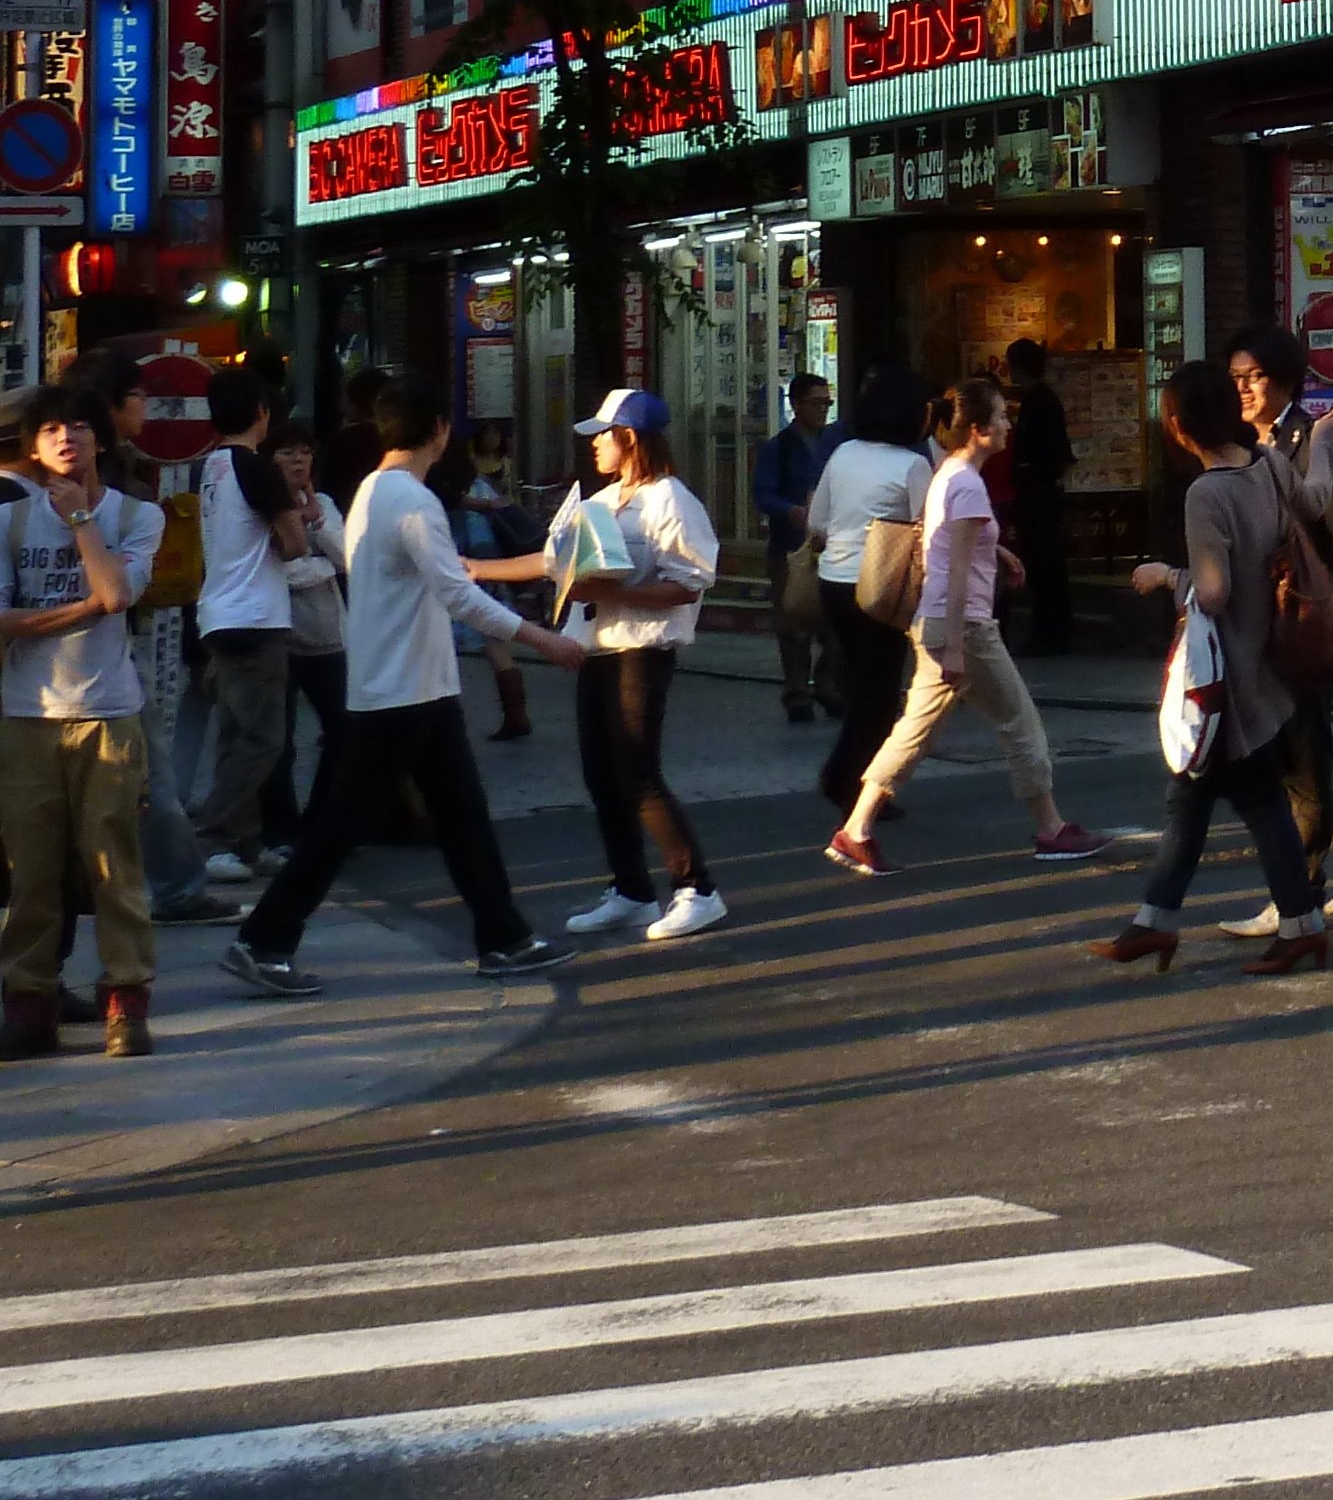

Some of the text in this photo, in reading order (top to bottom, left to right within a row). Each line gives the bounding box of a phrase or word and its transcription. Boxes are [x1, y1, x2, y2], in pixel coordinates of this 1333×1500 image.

[1018, 109, 1031, 130] 9F
[110, 57, 137, 232] ヤマモトコーヒー店
[915, 126, 927, 147] 7F
[169, 171, 216, 192] 白雪
[245, 240, 281, 255] MOA
[19, 548, 49, 569] BIG
[43, 573, 81, 594] FOR
